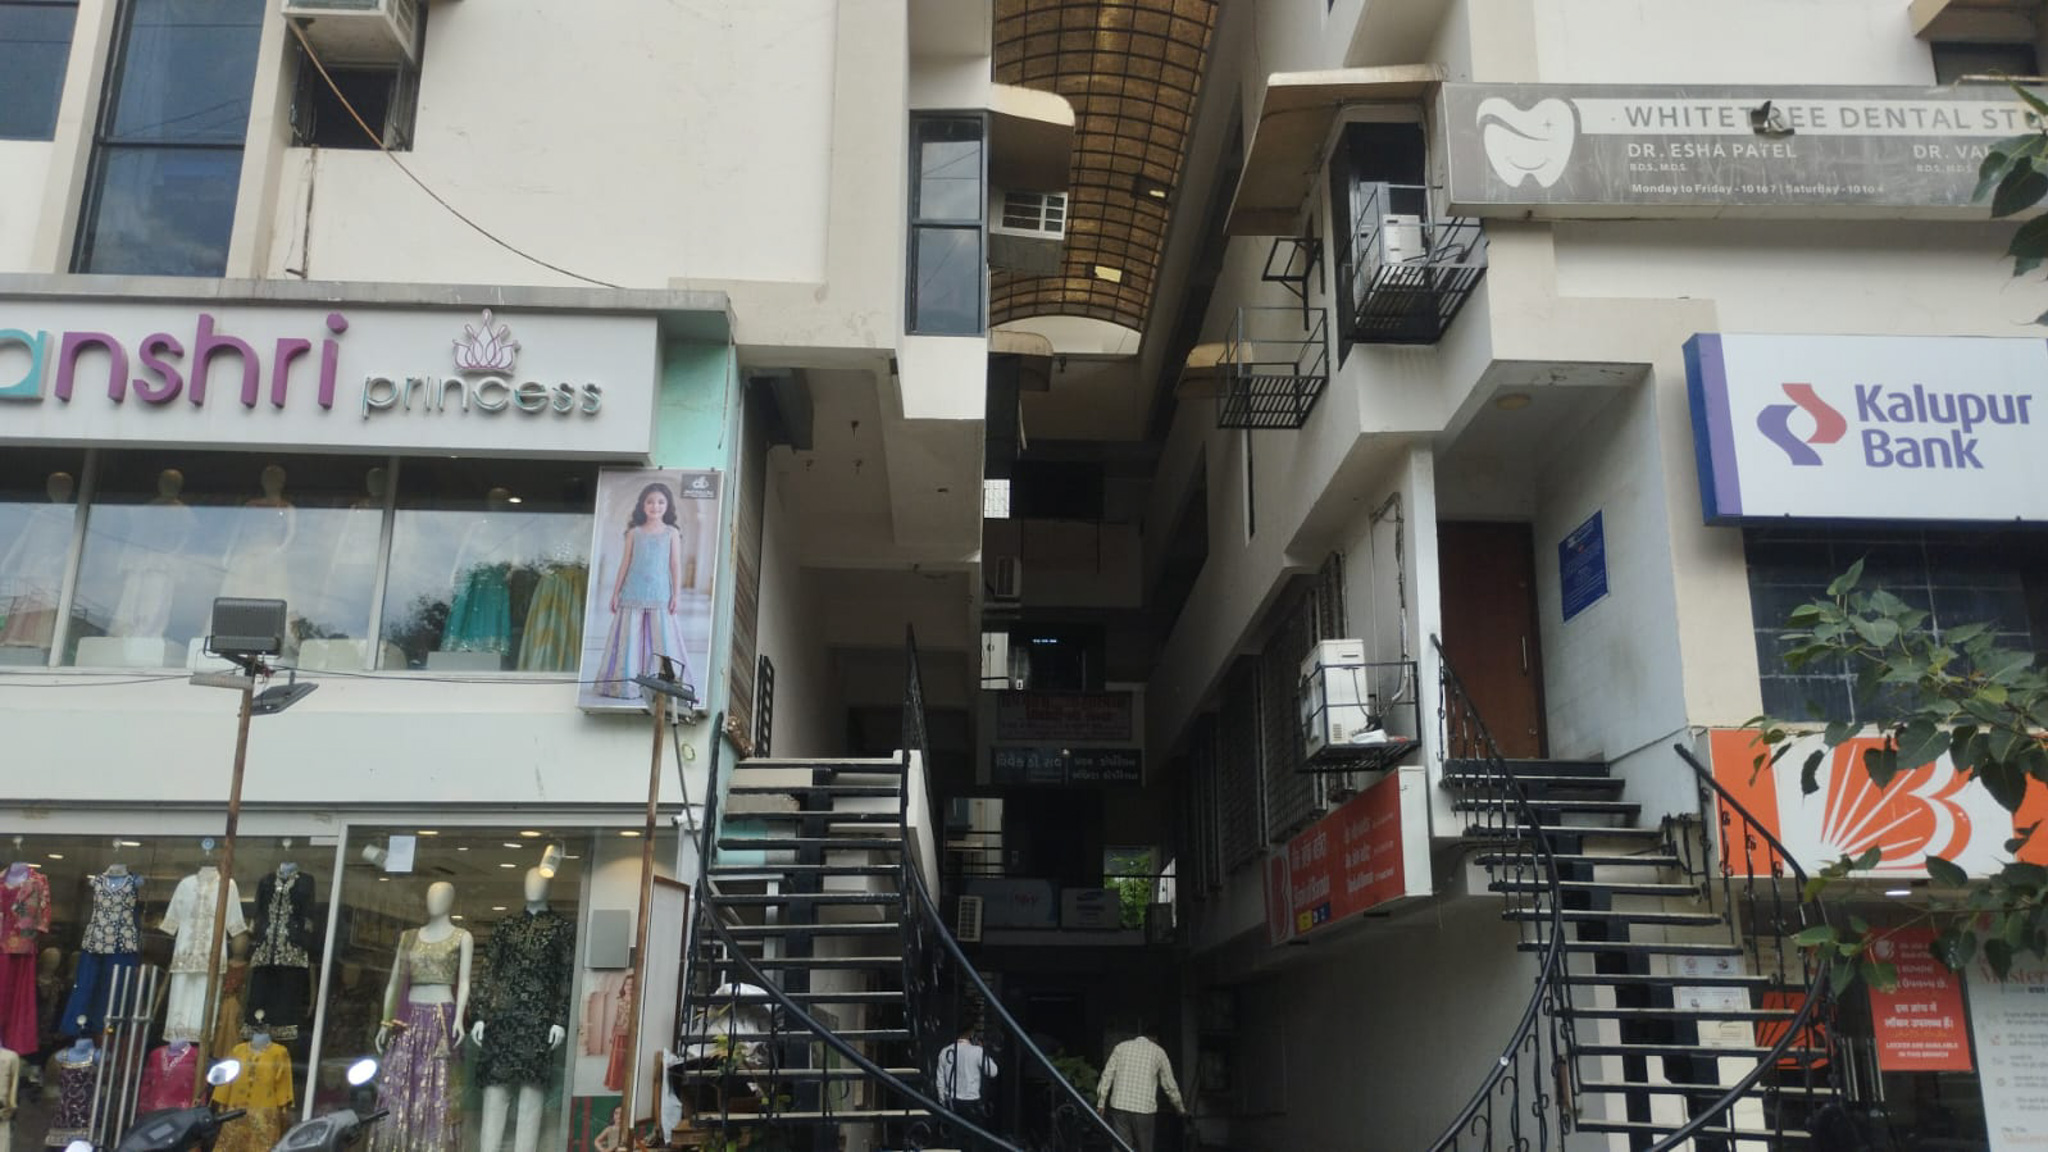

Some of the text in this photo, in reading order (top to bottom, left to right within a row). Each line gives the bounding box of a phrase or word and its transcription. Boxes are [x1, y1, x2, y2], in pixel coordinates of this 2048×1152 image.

[1839, 107, 1971, 129] DENTAL
[1628, 143, 1798, 158] DR. ESHA PATEL
[1913, 145, 1949, 159] DR.
[1632, 184, 1678, 196] Monday
[1681, 184, 1692, 193] to
[1695, 184, 1732, 196] Friday
[1741, 184, 1754, 193] 10
[1756, 184, 1767, 193] to
[1769, 185, 1776, 193] 7
[1786, 183, 1839, 195] Saturday
[1848, 185, 1859, 193] 10
[1862, 185, 1875, 193] to
[361, 376, 602, 421] princess
[1854, 382, 2032, 433] Kalupur
[1861, 428, 1984, 469] Bank
